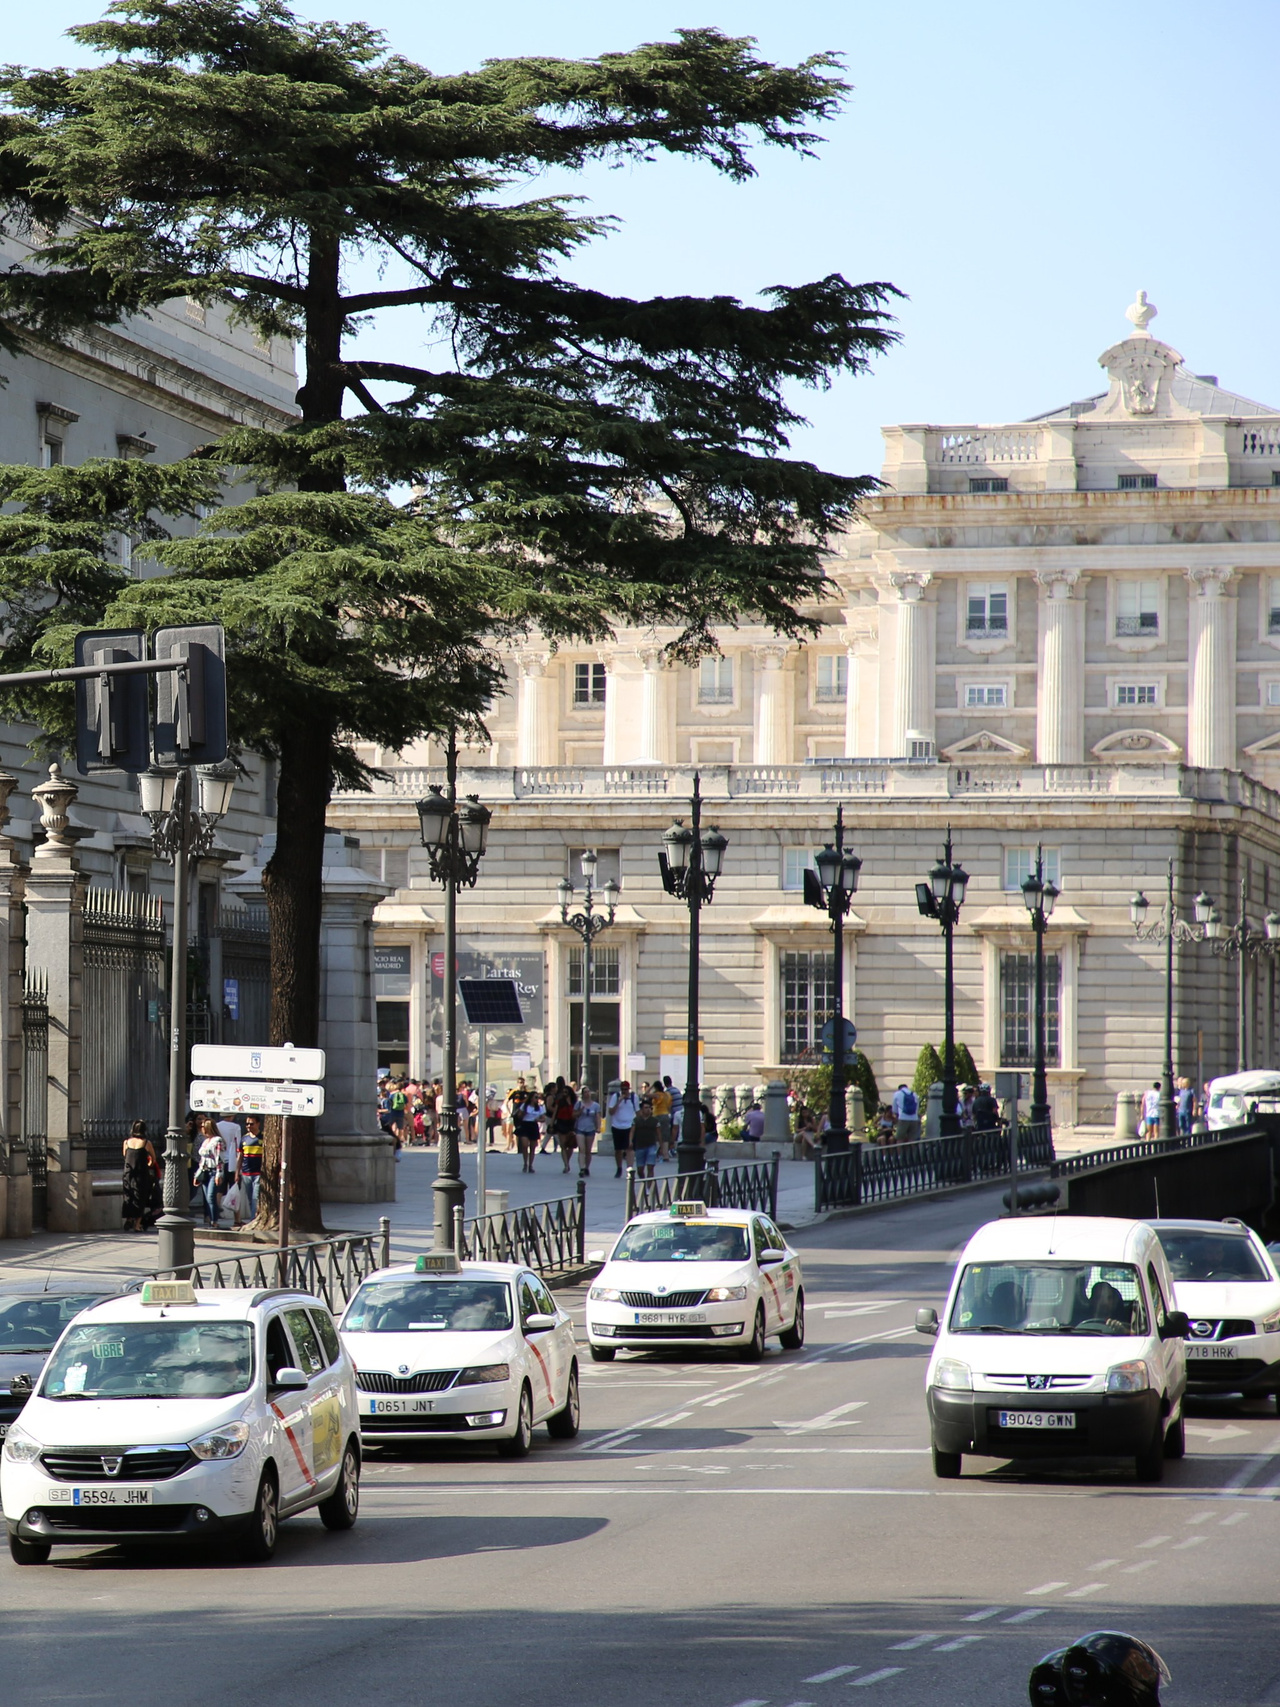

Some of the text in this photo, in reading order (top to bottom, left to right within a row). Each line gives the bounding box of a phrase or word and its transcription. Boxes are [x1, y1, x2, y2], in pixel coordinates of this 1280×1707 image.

[516, 981, 539, 997] Rey
[679, 1205, 693, 1213] TAXI
[426, 1257, 444, 1268] TAXI
[154, 1286, 177, 1299] TAXI
[641, 1314, 686, 1323] 9681 HYR
[94, 1344, 122, 1357] LIBRE
[1187, 1347, 1234, 1358] 718 HRK
[378, 1401, 434, 1411] 0651 JNT
[1009, 1414, 1072, 1427] 9049 GWN
[51, 1491, 68, 1499] SP
[83, 1491, 148, 1503] 5594 JHM
